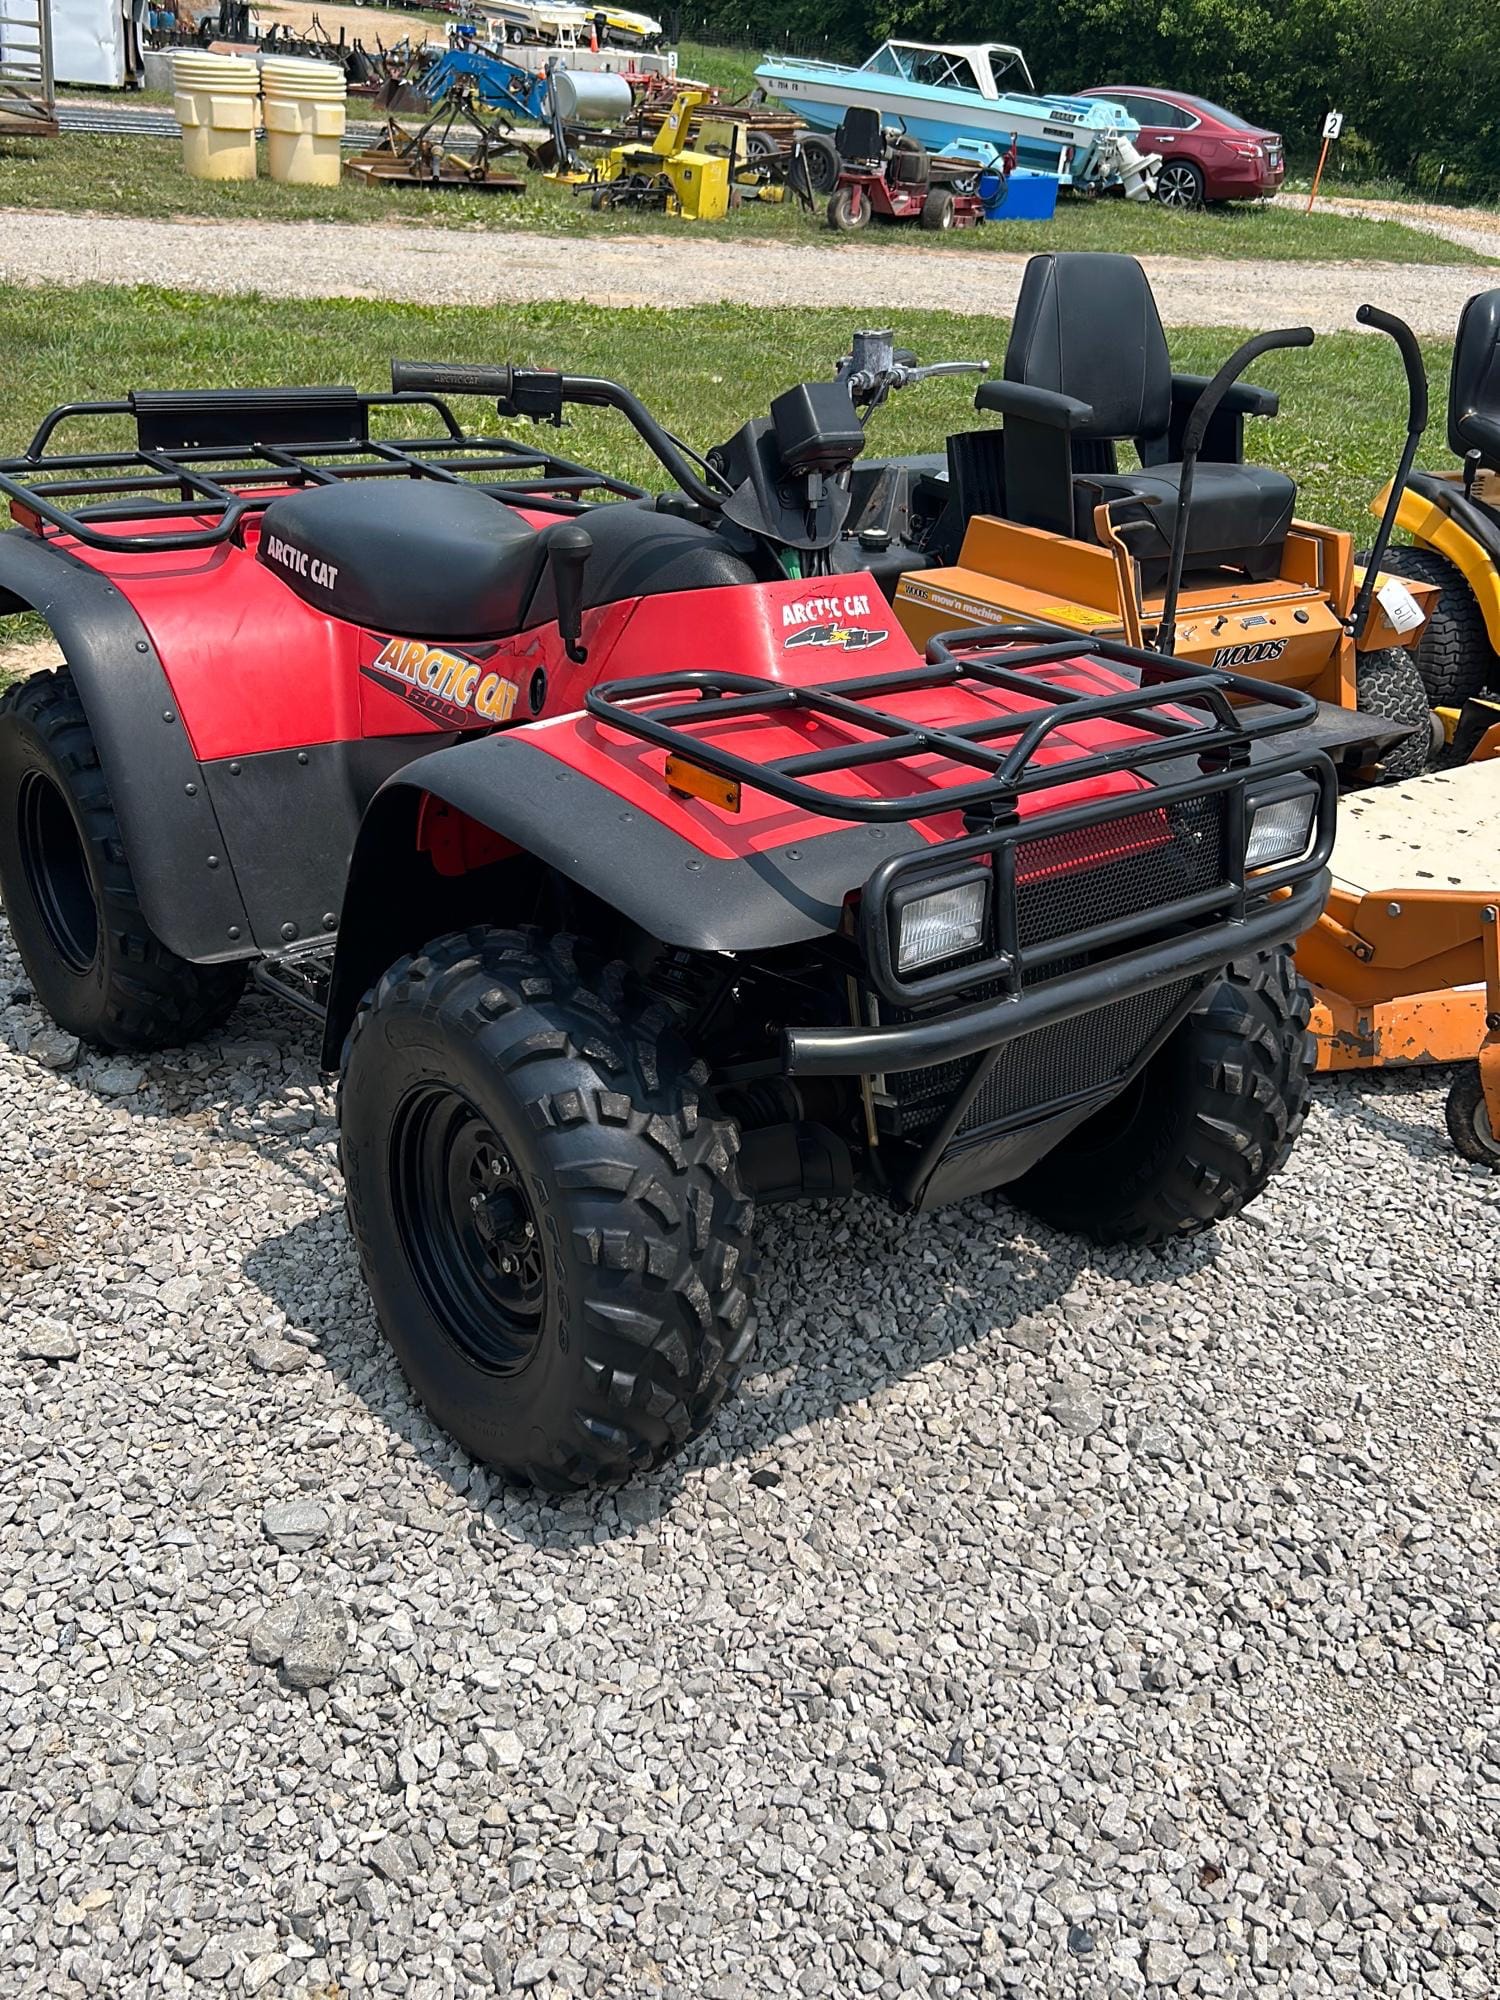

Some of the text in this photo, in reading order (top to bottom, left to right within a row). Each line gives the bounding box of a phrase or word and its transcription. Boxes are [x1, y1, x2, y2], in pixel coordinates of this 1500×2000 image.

[671, 54, 676, 66] 3
[1328, 117, 1338, 134] 2
[434, 373, 480, 385] ARCTIC CAT
[267, 535, 338, 590] ARCTIC CAT
[782, 595, 871, 627] ARCTIC CAT
[931, 593, 962, 609] mow'n
[962, 602, 1003, 622] machine
[1210, 638, 1290, 670] WOODS
[373, 638, 519, 722] ARCTIC CAT
[407, 688, 468, 725] 500
